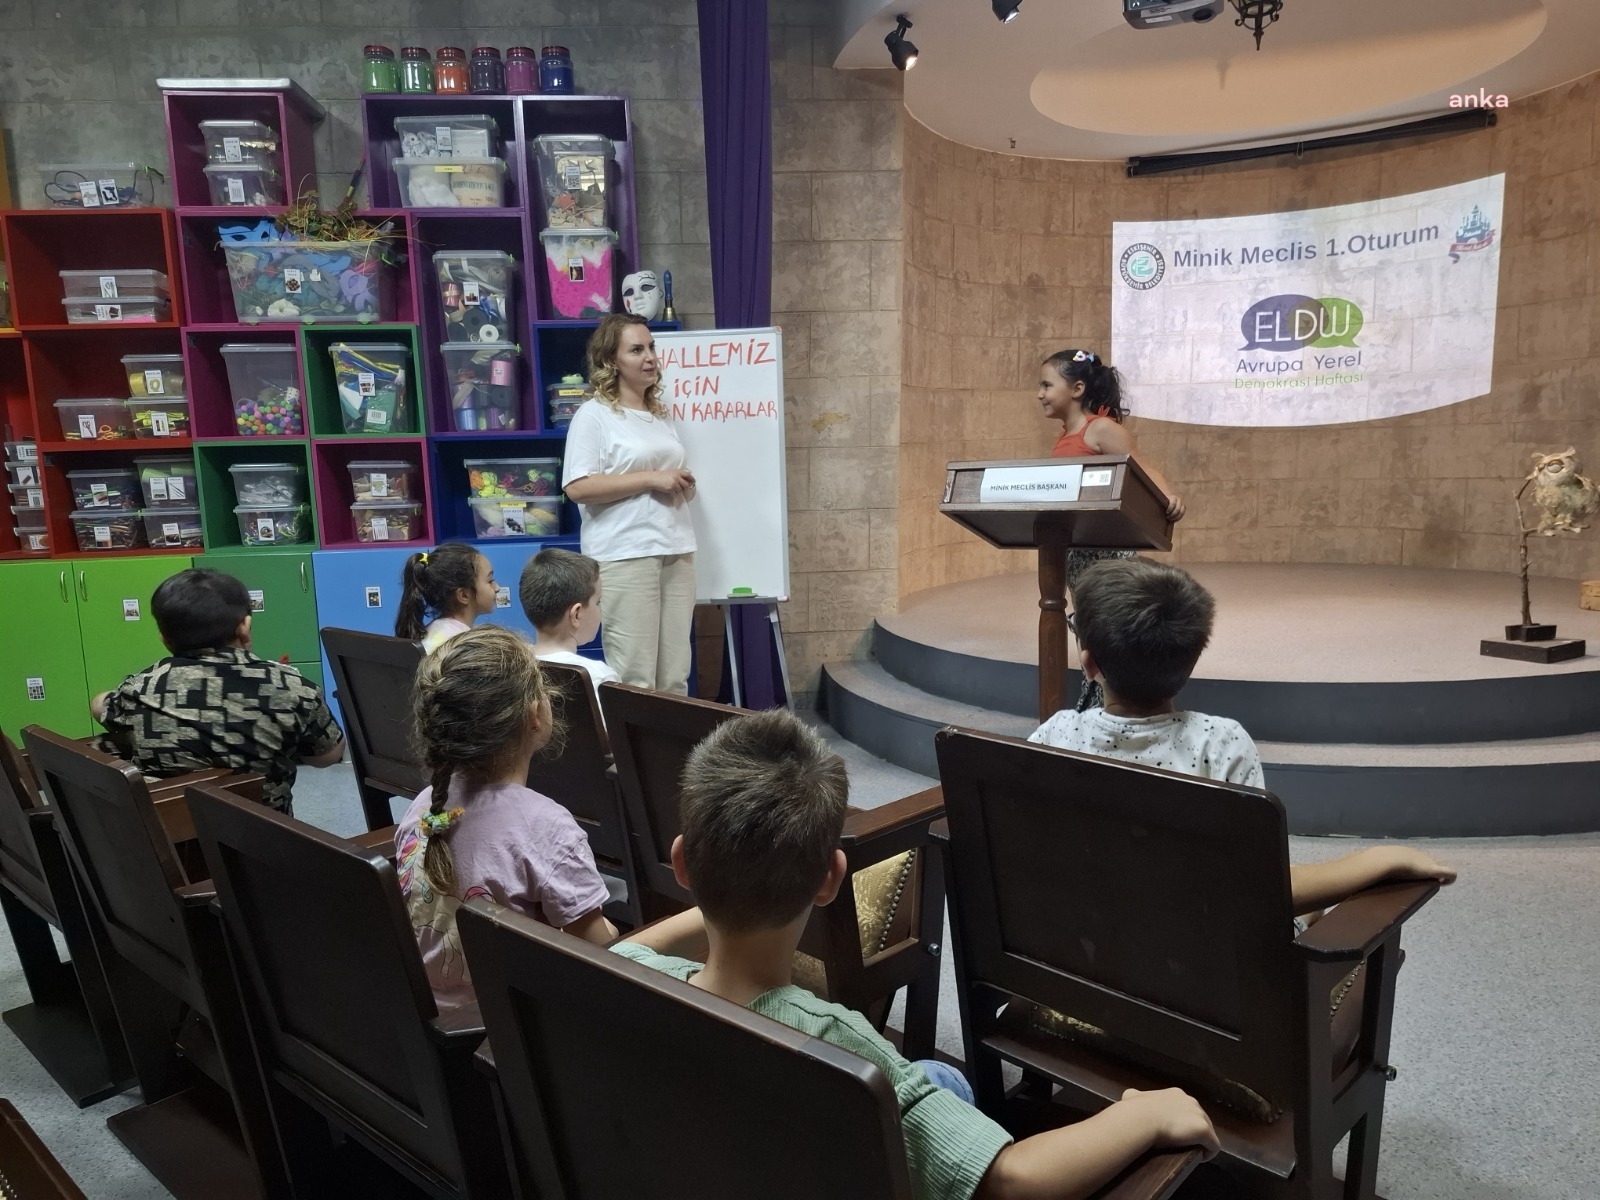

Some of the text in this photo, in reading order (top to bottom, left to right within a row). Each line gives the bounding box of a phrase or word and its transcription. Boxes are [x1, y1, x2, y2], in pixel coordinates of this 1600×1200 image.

[1174, 248, 1233, 267] Minik
[1241, 242, 1317, 264] Meclis
[1325, 225, 1439, 257] 1.Oturum
[1255, 304, 1350, 343] ELDW
[1236, 351, 1361, 375] Avrupa Yerel
[1234, 372, 1363, 389] Demokrasi Haftası
[691, 401, 777, 423] KARARLAR
[1010, 483, 1036, 491] MECLİS
[1036, 483, 1067, 491] BAŞKANI
